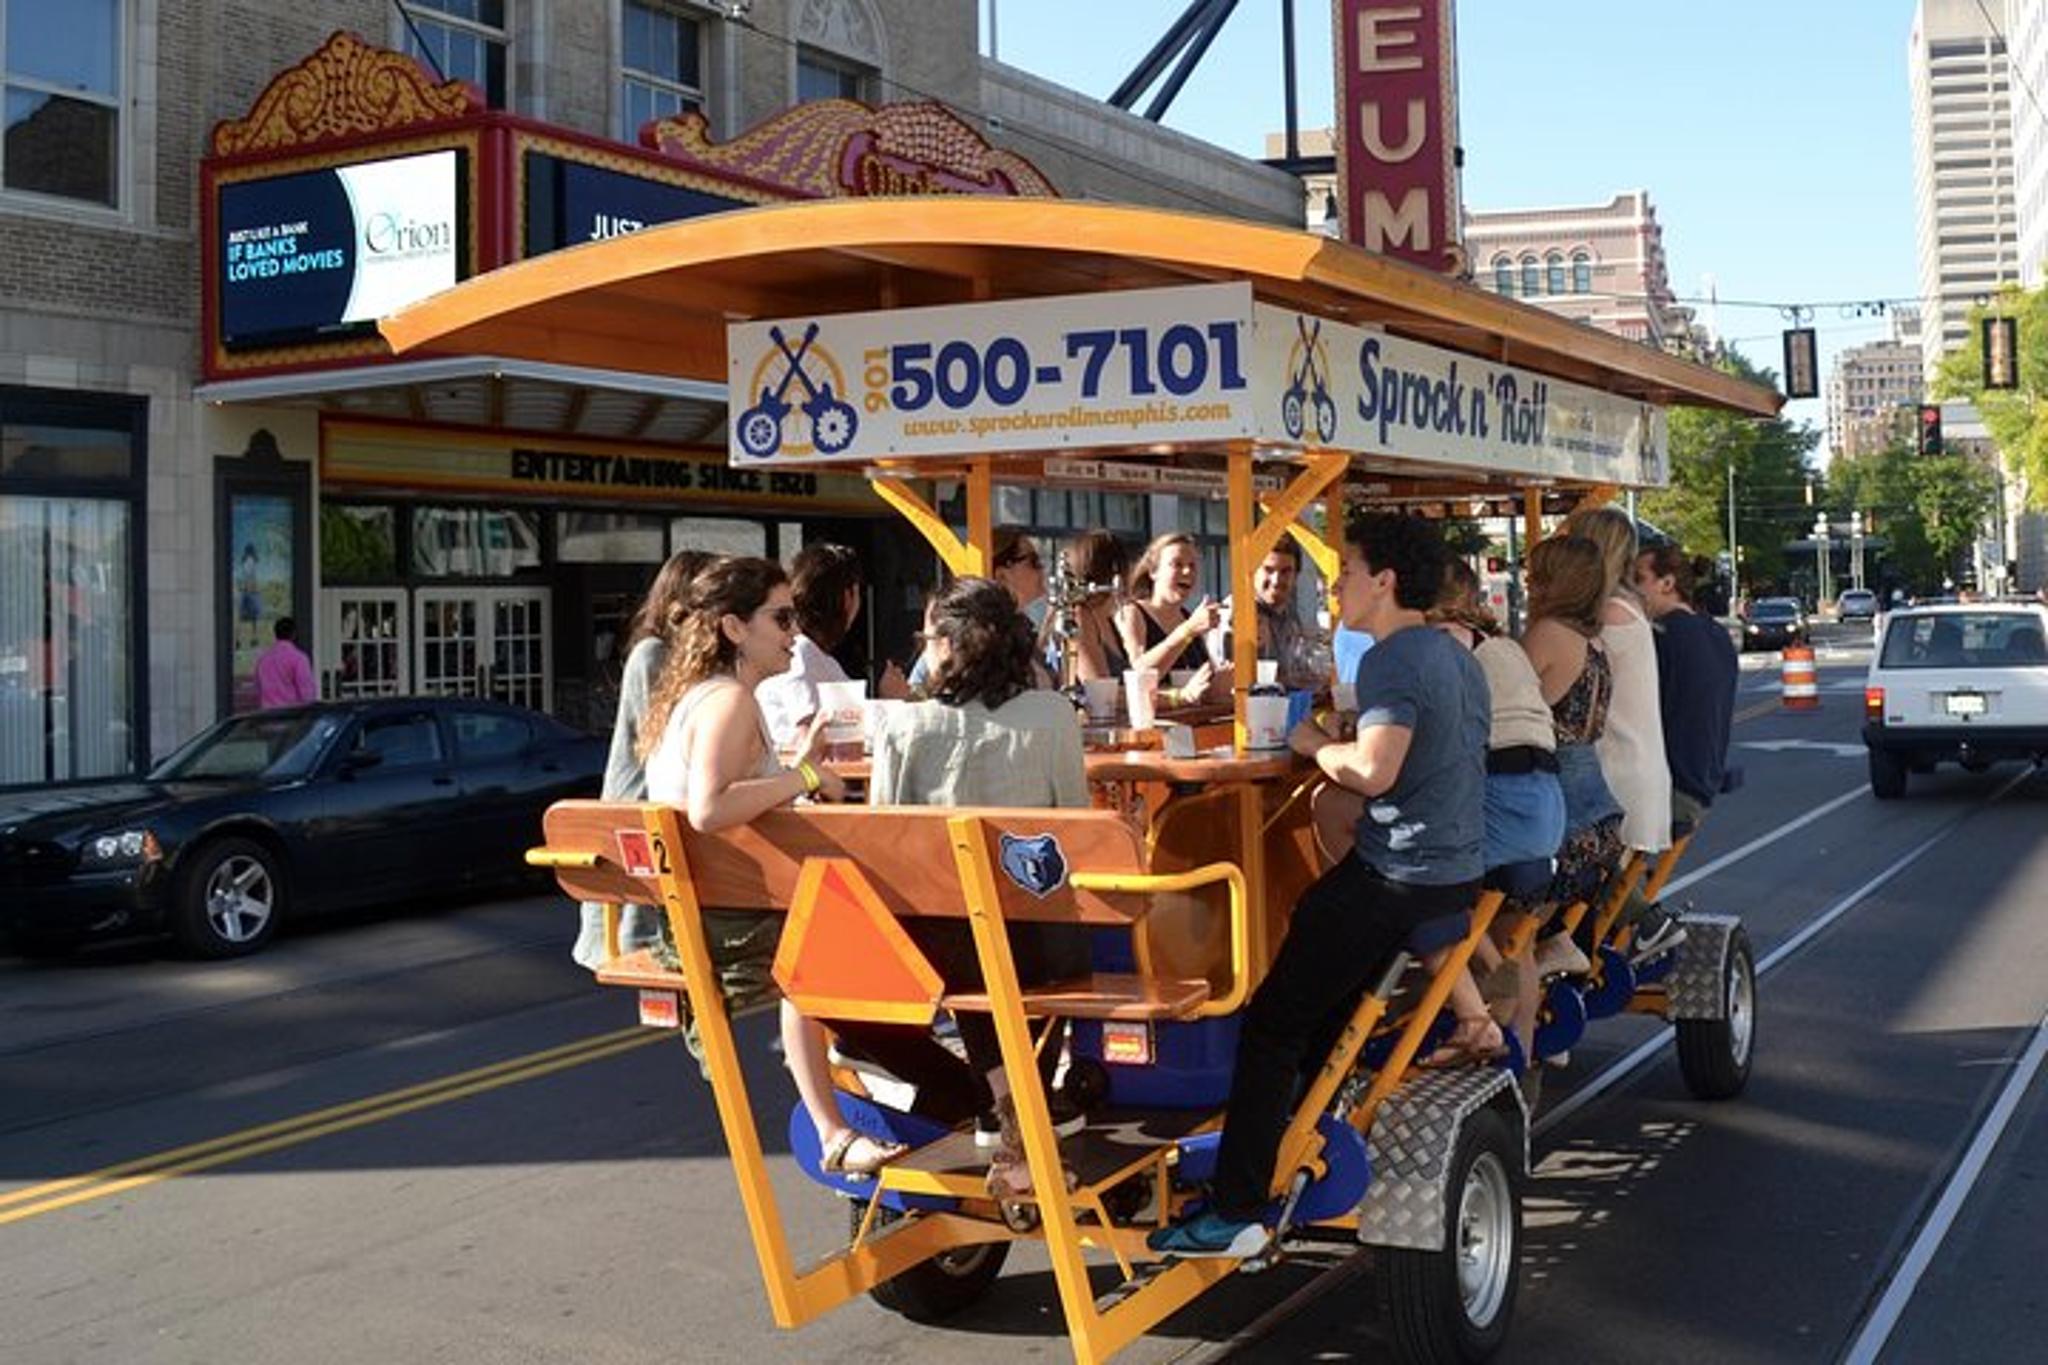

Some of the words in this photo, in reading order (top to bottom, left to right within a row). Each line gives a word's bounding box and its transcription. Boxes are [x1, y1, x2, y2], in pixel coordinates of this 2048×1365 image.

[1357, 7, 1431, 254] EUM
[228, 243, 242, 261] IF
[245, 236, 296, 260] BANKS
[364, 212, 450, 253] Orion
[229, 258, 280, 282] LOVED
[282, 249, 344, 274] MOVIES
[864, 346, 889, 413] 901
[891, 322, 1246, 411] 500-7101
[1357, 337, 1466, 445] Sprock
[904, 399, 1231, 438] www.sprocknrollmemphis.com
[512, 449, 692, 488] ENTERTAINING
[699, 463, 763, 492] SINCE
[653, 838, 671, 874] 2
